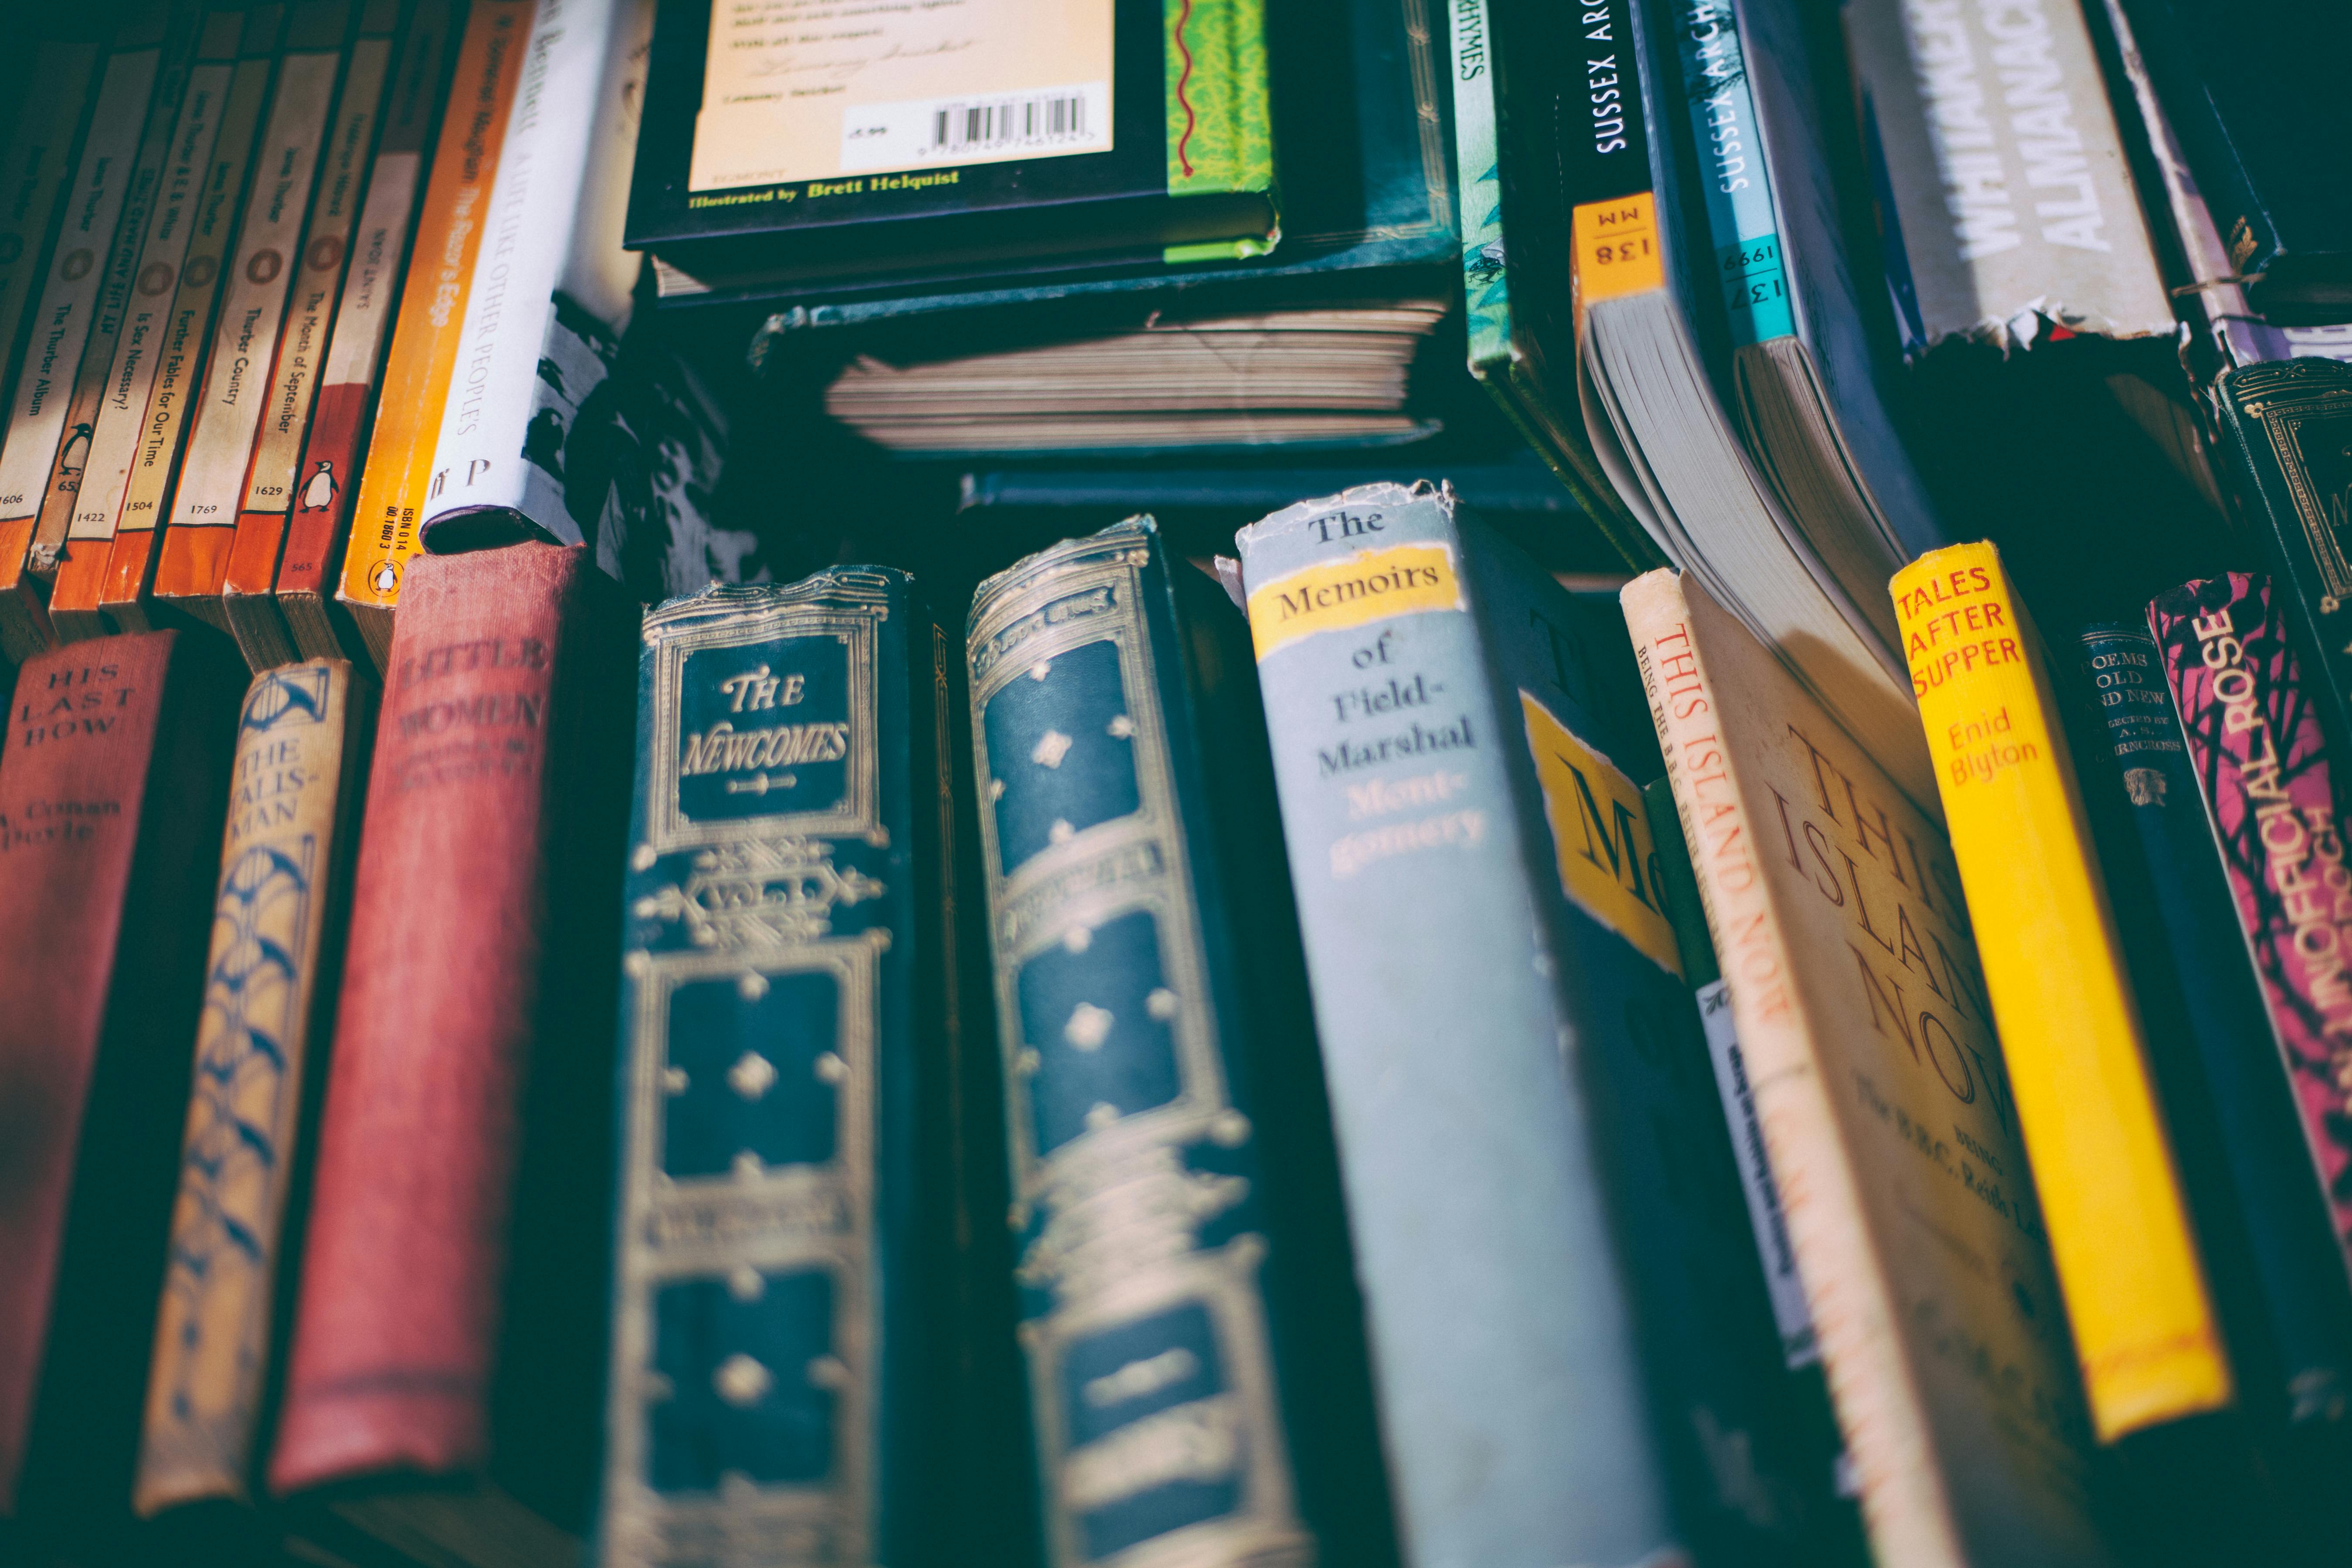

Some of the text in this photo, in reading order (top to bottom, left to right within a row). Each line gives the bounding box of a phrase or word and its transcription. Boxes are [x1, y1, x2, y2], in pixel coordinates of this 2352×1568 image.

[722, 92, 783, 105] Lemony
[1588, 54, 1626, 154] SUSSEX
[1703, 90, 1749, 193] SUSSEX
[689, 169, 959, 208] Illustrated by Brett Helquist
[1598, 207, 1639, 226] MM
[1596, 238, 1649, 265] 138
[1723, 245, 1774, 270] 1999
[428, 283, 461, 328] Edge
[477, 262, 509, 340] OTHER
[1730, 279, 1781, 310] 137
[101, 314, 118, 335] MY
[28, 303, 72, 416] The Thurber Album
[112, 313, 152, 410] Is Sex Necessary?
[222, 306, 262, 406] Thurber Country
[278, 292, 325, 434] The Month of September
[144, 309, 195, 467] Further Fables for Our Time
[457, 343, 493, 436] PEOPLE'S
[255, 486, 283, 496] 1629
[463, 459, 491, 487] P
[77, 513, 105, 522] 1422
[126, 501, 153, 512] 1504
[191, 505, 218, 514] 1769
[400, 507, 414, 530] ISBN
[1307, 510, 1386, 545] The
[291, 562, 313, 572] 565
[396, 540, 408, 551] 14
[1274, 564, 1441, 624] Memoirs
[1897, 566, 1991, 622] TALES
[1352, 629, 1394, 669] of
[1908, 601, 2005, 661] AFTER
[49, 664, 119, 689] HIS
[397, 636, 549, 690] LITTLE
[1911, 637, 2021, 699] SUPPER
[2095, 670, 2143, 689] OLD
[2191, 608, 2264, 735] ROSE
[21, 687, 134, 724] LAST
[720, 664, 805, 714] THE
[1333, 674, 1446, 723] Field-
[2125, 689, 2166, 705] NEW
[398, 692, 541, 739] WOMEN
[1638, 645, 1659, 699] BEING
[1653, 701, 1669, 740] THE
[1664, 742, 1683, 794] B.B.C.
[1947, 705, 2011, 751] Enid
[239, 738, 301, 781] THE
[679, 720, 849, 777] NEWCOMES
[1316, 716, 1477, 778] Marshal
[1655, 623, 1708, 720] THIS
[1684, 734, 1754, 893] ISLAND
[1949, 739, 2039, 788] Blyton
[25, 797, 121, 821] Conan
[1328, 808, 1486, 881] gomery
